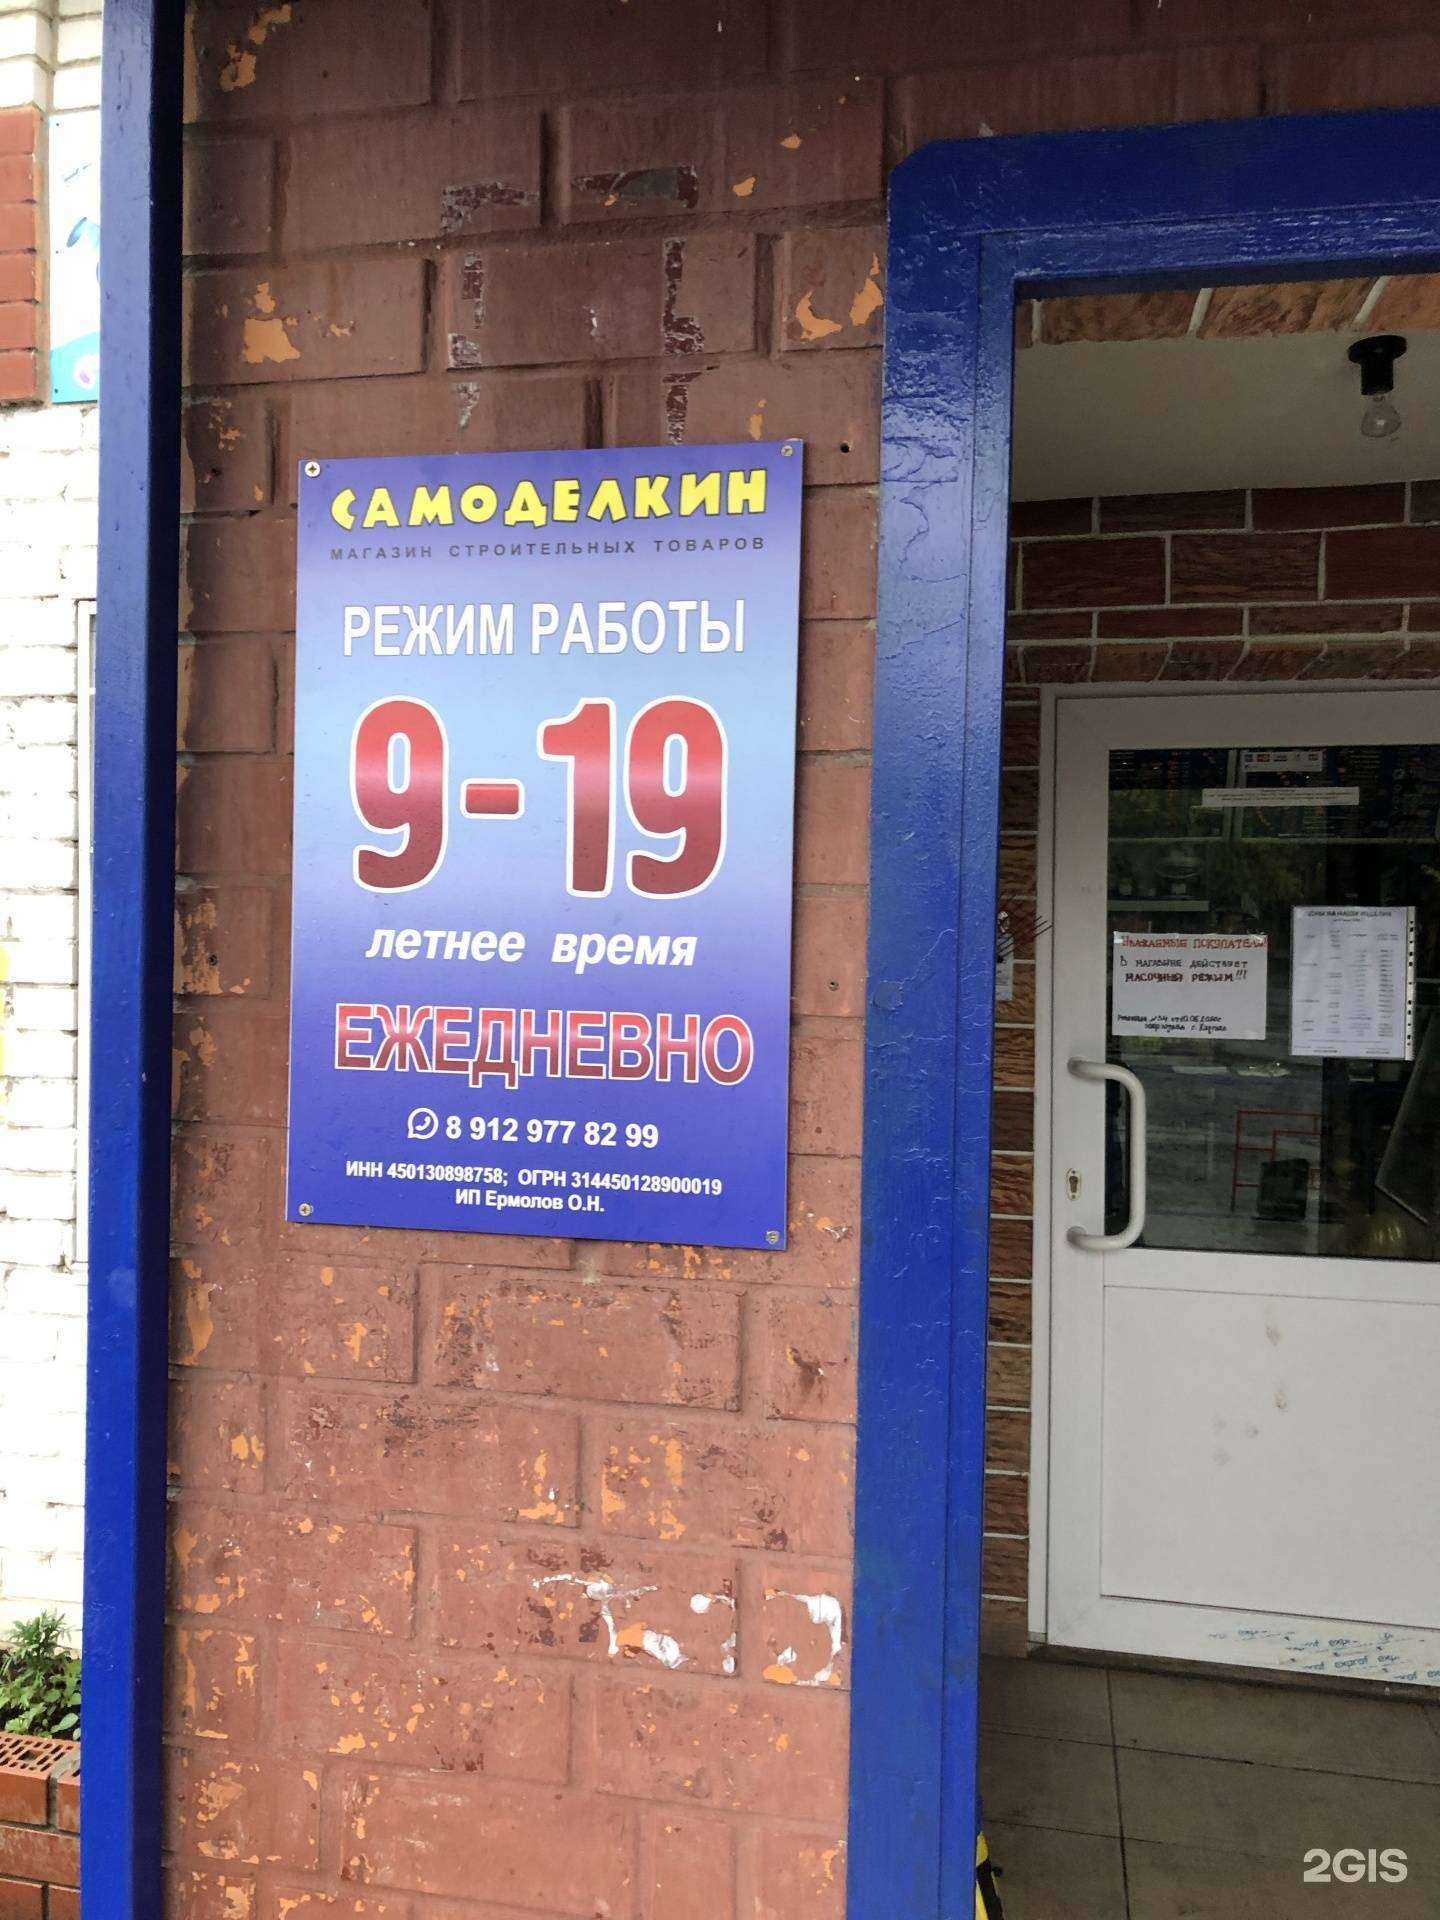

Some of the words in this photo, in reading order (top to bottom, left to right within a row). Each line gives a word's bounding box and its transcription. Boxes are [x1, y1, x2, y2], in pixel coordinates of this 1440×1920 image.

[330, 469, 768, 530] САМОДЕЛКИН
[330, 545, 433, 560] МАГАЗИН
[449, 540, 636, 557] СТРОИТЕЛЬНЫХ
[655, 537, 765, 553] ТОВАРОВ
[343, 603, 515, 656] РЕЖИМ
[531, 600, 745, 655] РАБОТЫ
[366, 928, 526, 962] летнее
[552, 933, 697, 974] время
[335, 1003, 754, 1090] ЕЖЕДНЕВНО
[446, 1115, 461, 1139] 8
[470, 1116, 518, 1142] 912
[527, 1119, 576, 1144] 977
[584, 1122, 617, 1146] 82
[625, 1124, 659, 1148] 99
[346, 1161, 382, 1177] ИНН
[387, 1163, 508, 1187] 450130898758;
[518, 1169, 566, 1187] ОГРН
[571, 1172, 722, 1195] 314450128900019
[456, 1189, 480, 1205] ИП
[485, 1190, 564, 1210] Ермолов
[568, 1195, 605, 1211] О.Н.
